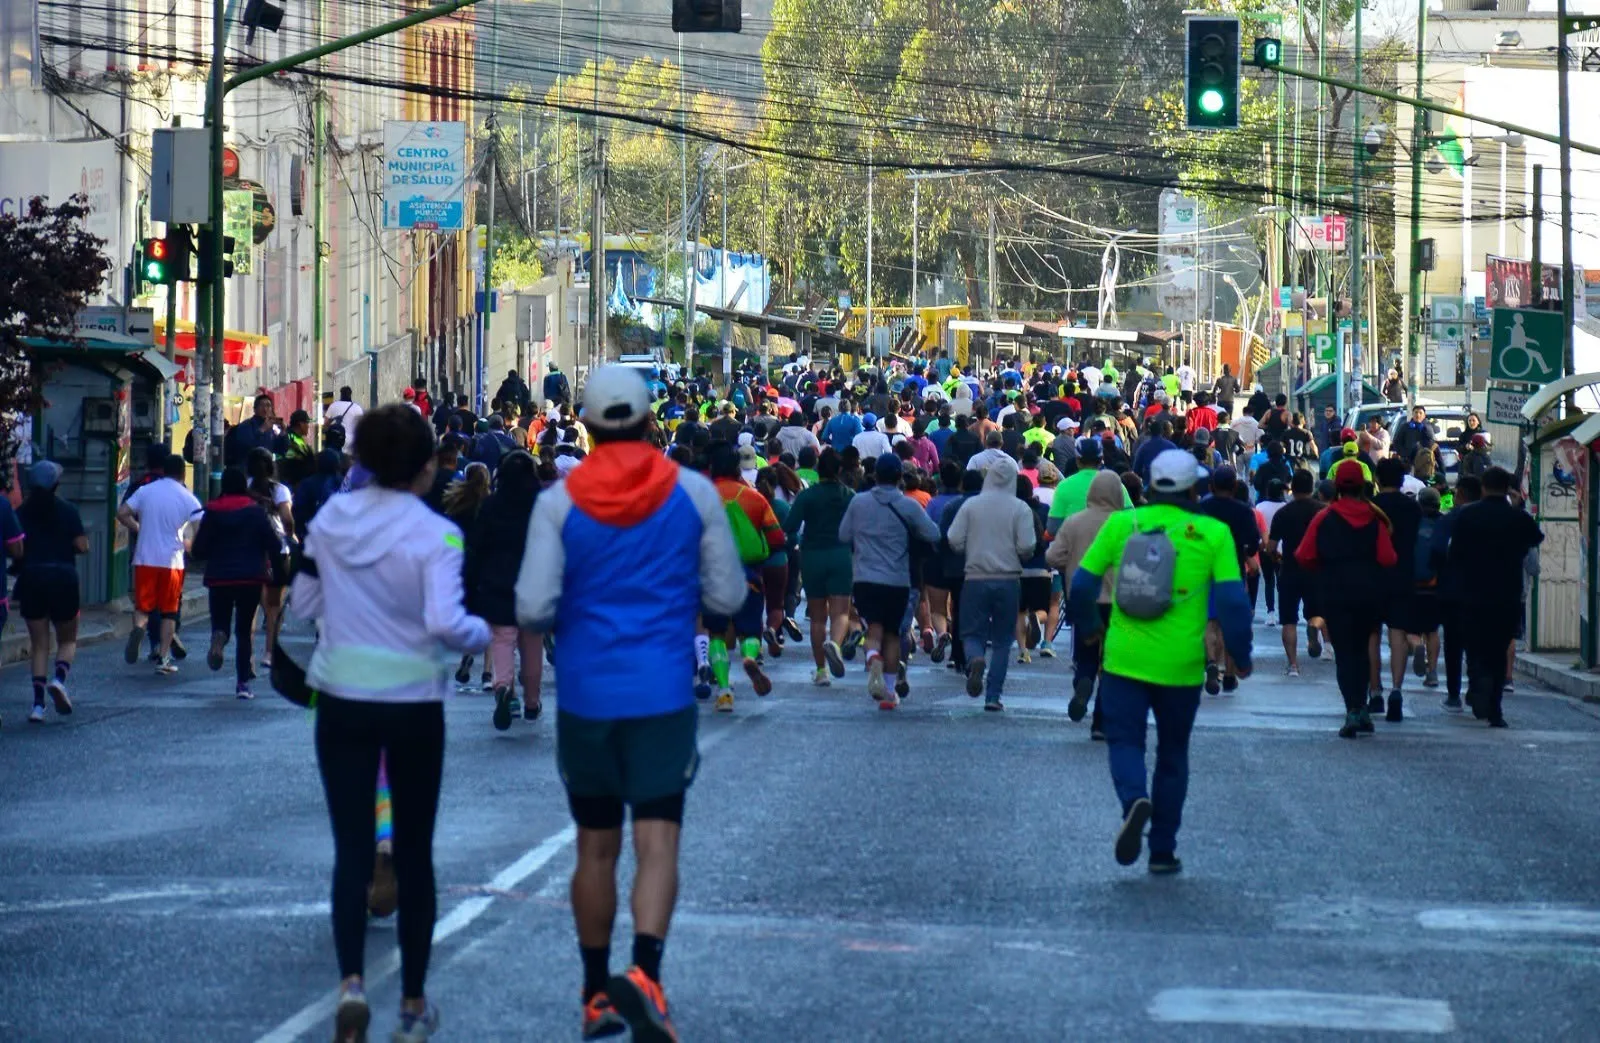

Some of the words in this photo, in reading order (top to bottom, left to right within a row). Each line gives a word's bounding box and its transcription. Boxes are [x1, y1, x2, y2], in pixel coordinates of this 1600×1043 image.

[397, 148, 449, 158] CENTRO
[388, 161, 457, 172] MUNICIPAL
[392, 175, 409, 185] DE
[411, 175, 454, 185] SALUD
[408, 202, 453, 210] ASISTENCIA
[153, 241, 163, 257] 6
[1435, 302, 1460, 334] P
[1315, 335, 1332, 358] P
[1289, 438, 1304, 457] 19
